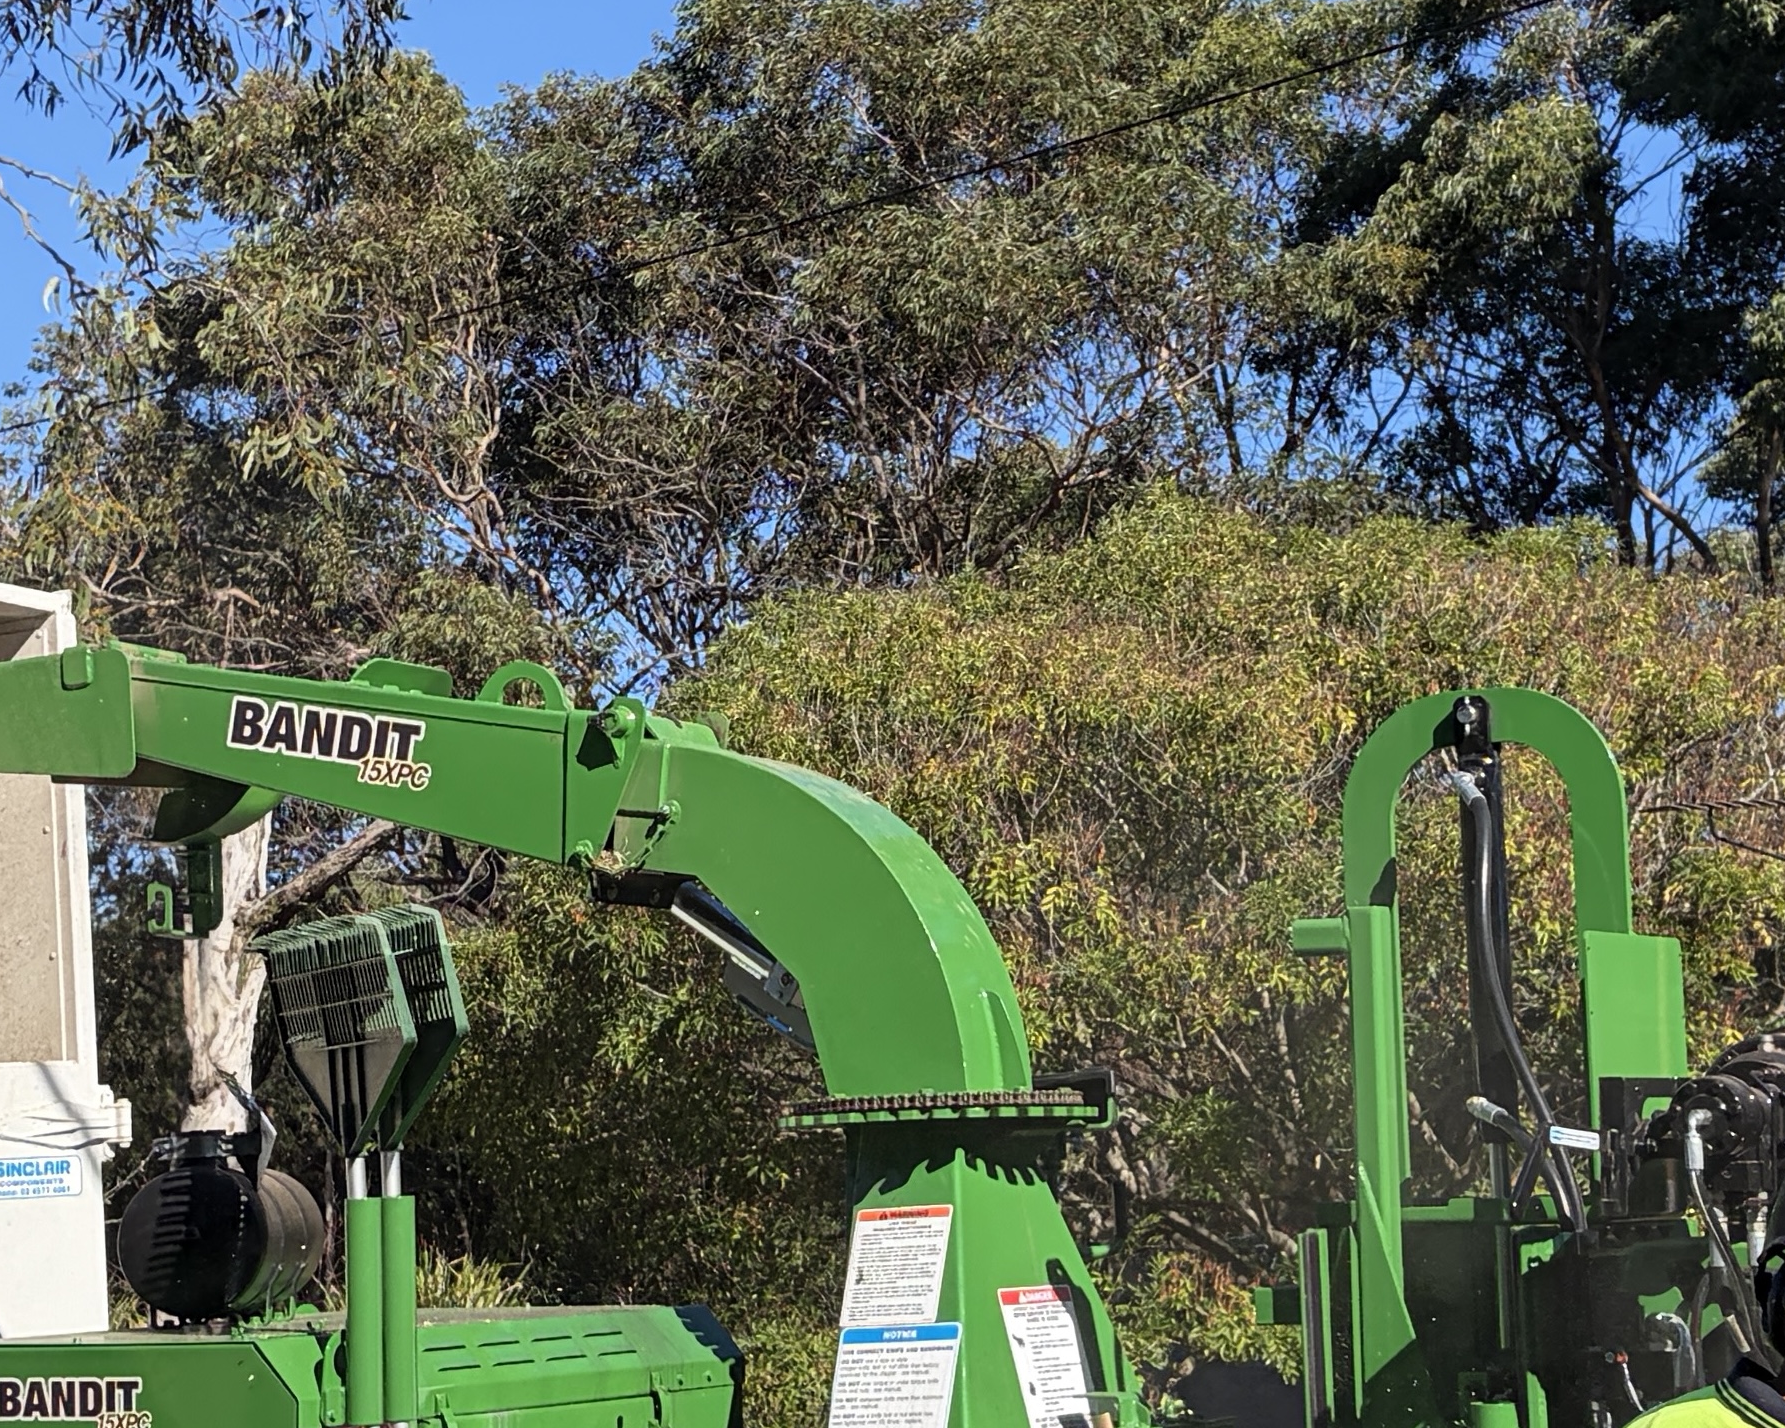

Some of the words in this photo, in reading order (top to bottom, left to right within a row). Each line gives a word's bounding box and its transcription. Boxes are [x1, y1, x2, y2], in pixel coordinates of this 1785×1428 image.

[229, 698, 424, 762] BANDIT
[358, 758, 430, 789] 15XPC
[0, 1177, 64, 1187] COMPONENTS
[882, 1329, 917, 1340] NOTICE
